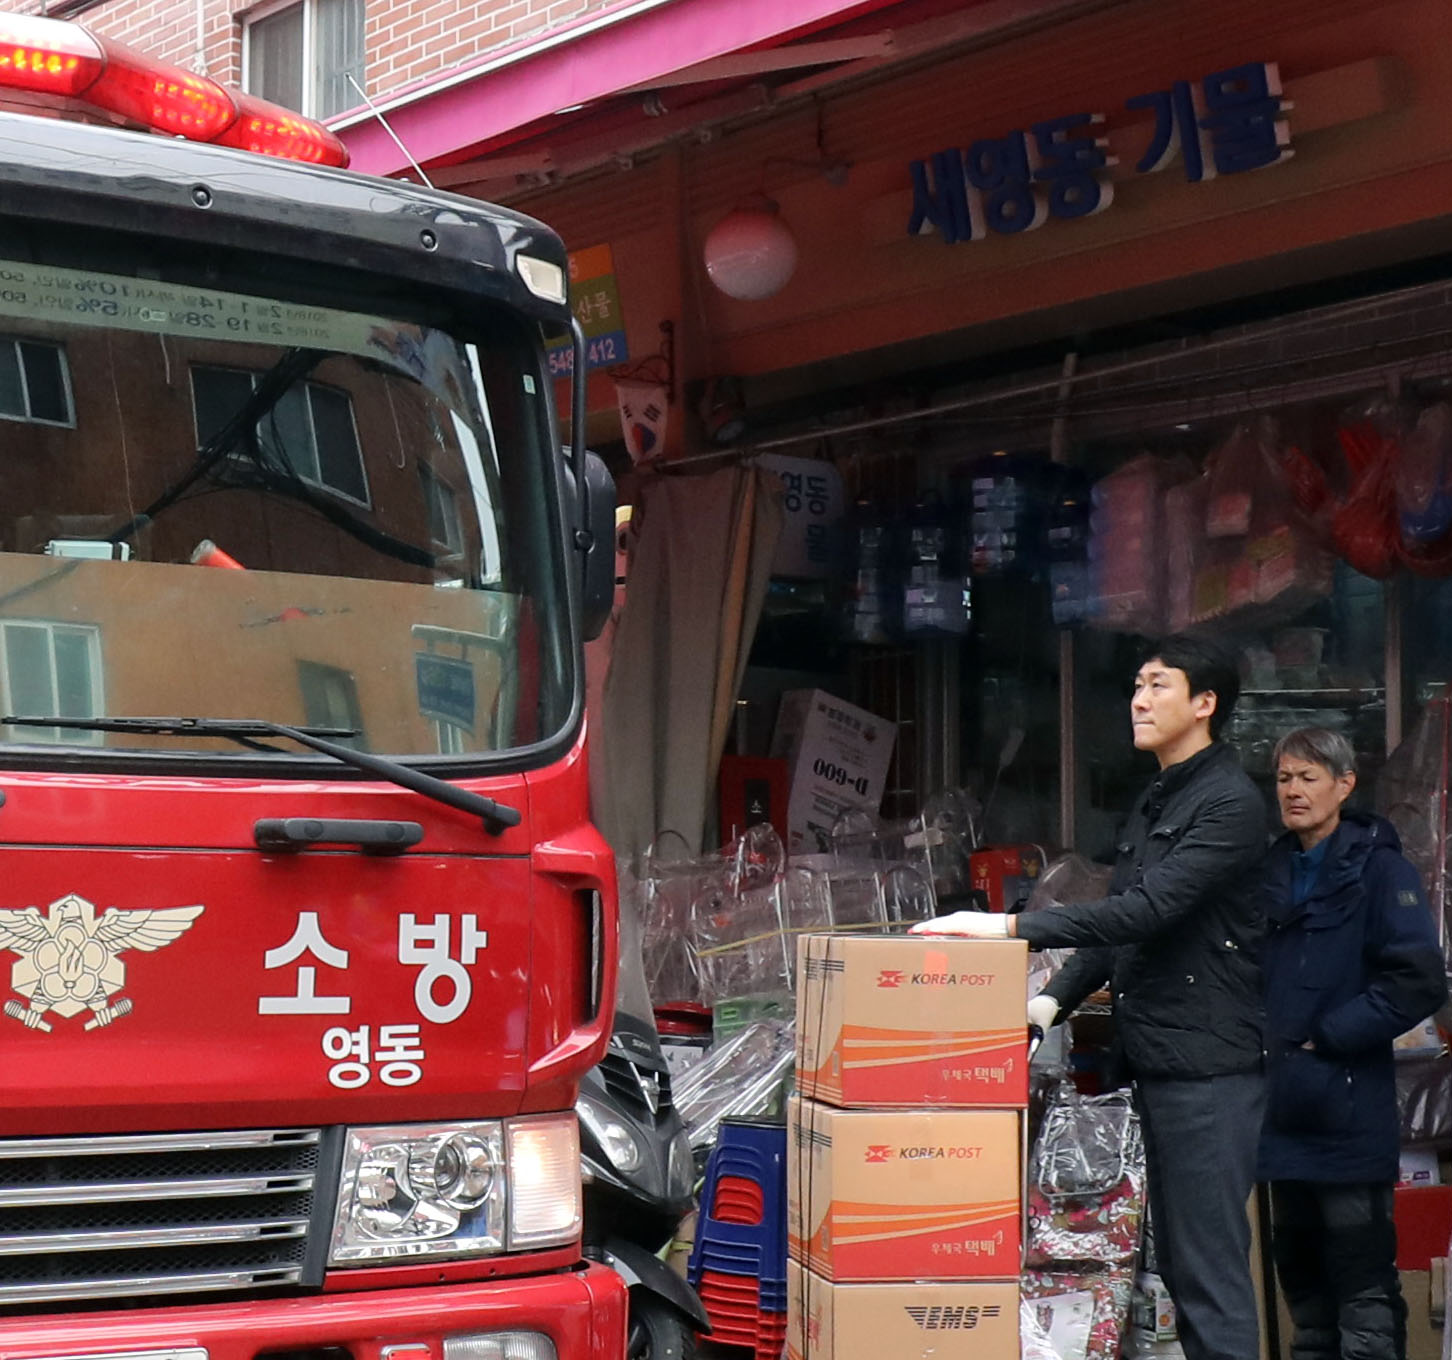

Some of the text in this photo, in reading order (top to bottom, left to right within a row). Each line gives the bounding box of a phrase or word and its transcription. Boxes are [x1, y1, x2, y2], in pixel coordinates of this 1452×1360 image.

[907, 60, 1294, 245] 새영동 기물
[813, 757, 869, 797] D-600
[258, 910, 487, 1023] 소방
[911, 973, 995, 986] KOREA POST
[322, 1023, 425, 1089] 영동
[974, 1066, 1006, 1084] 택배
[899, 1146, 983, 1159] KOREA POST
[964, 1239, 996, 1257] 택배
[925, 1305, 980, 1330] EMS
